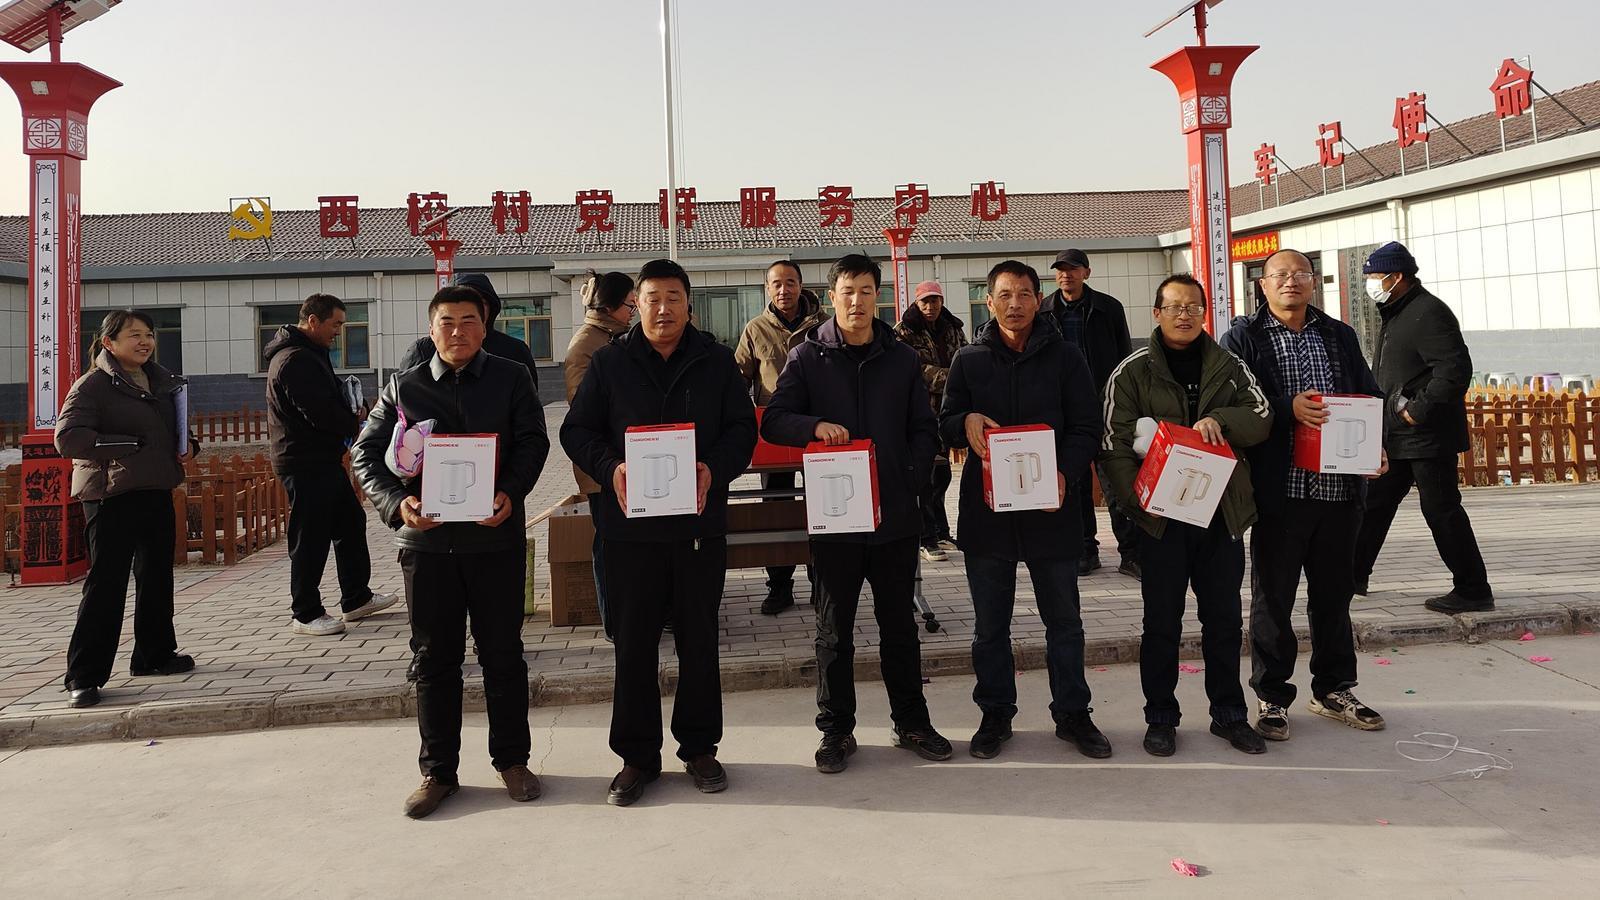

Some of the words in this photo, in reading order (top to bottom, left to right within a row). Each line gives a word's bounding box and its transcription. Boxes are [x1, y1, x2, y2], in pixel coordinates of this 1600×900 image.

[1254, 58, 1534, 186] 牢记使命
[41, 264, 52, 322] 城乡互补
[1212, 191, 1226, 318] 建设宜居宜业和美乡村
[41, 334, 52, 392] 协调发展
